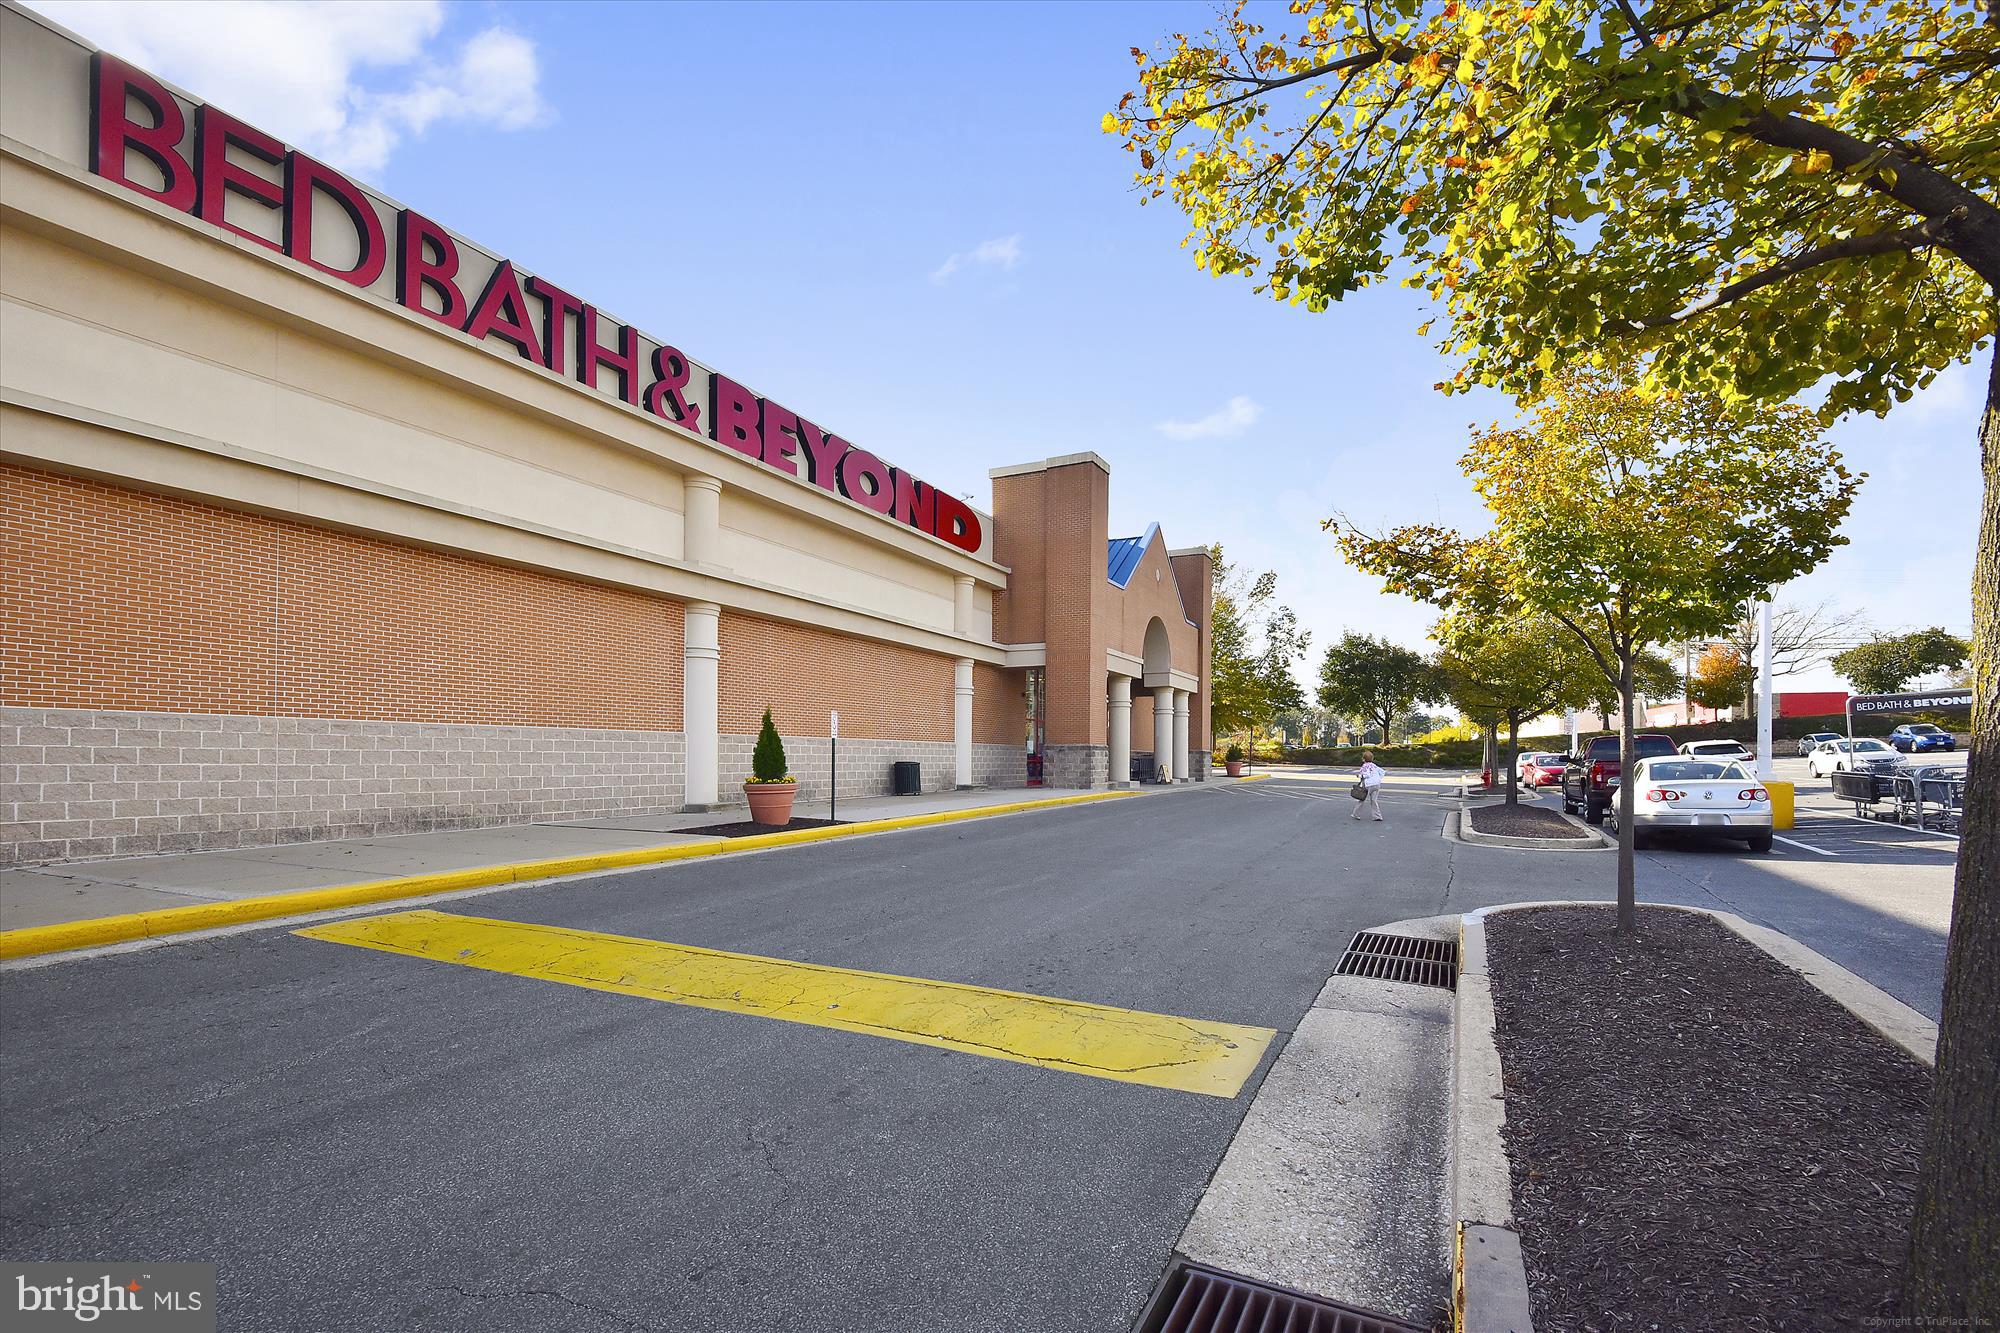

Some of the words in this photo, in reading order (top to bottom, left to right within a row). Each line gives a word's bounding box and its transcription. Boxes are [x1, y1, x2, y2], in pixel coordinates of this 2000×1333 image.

[90, 50, 386, 288] BED
[397, 209, 638, 407] BATH
[643, 346, 702, 434] &
[709, 373, 982, 553] BEYOND
[1856, 701, 1875, 711] BED
[1877, 700, 1902, 710] BATH
[1904, 699, 1912, 708] &
